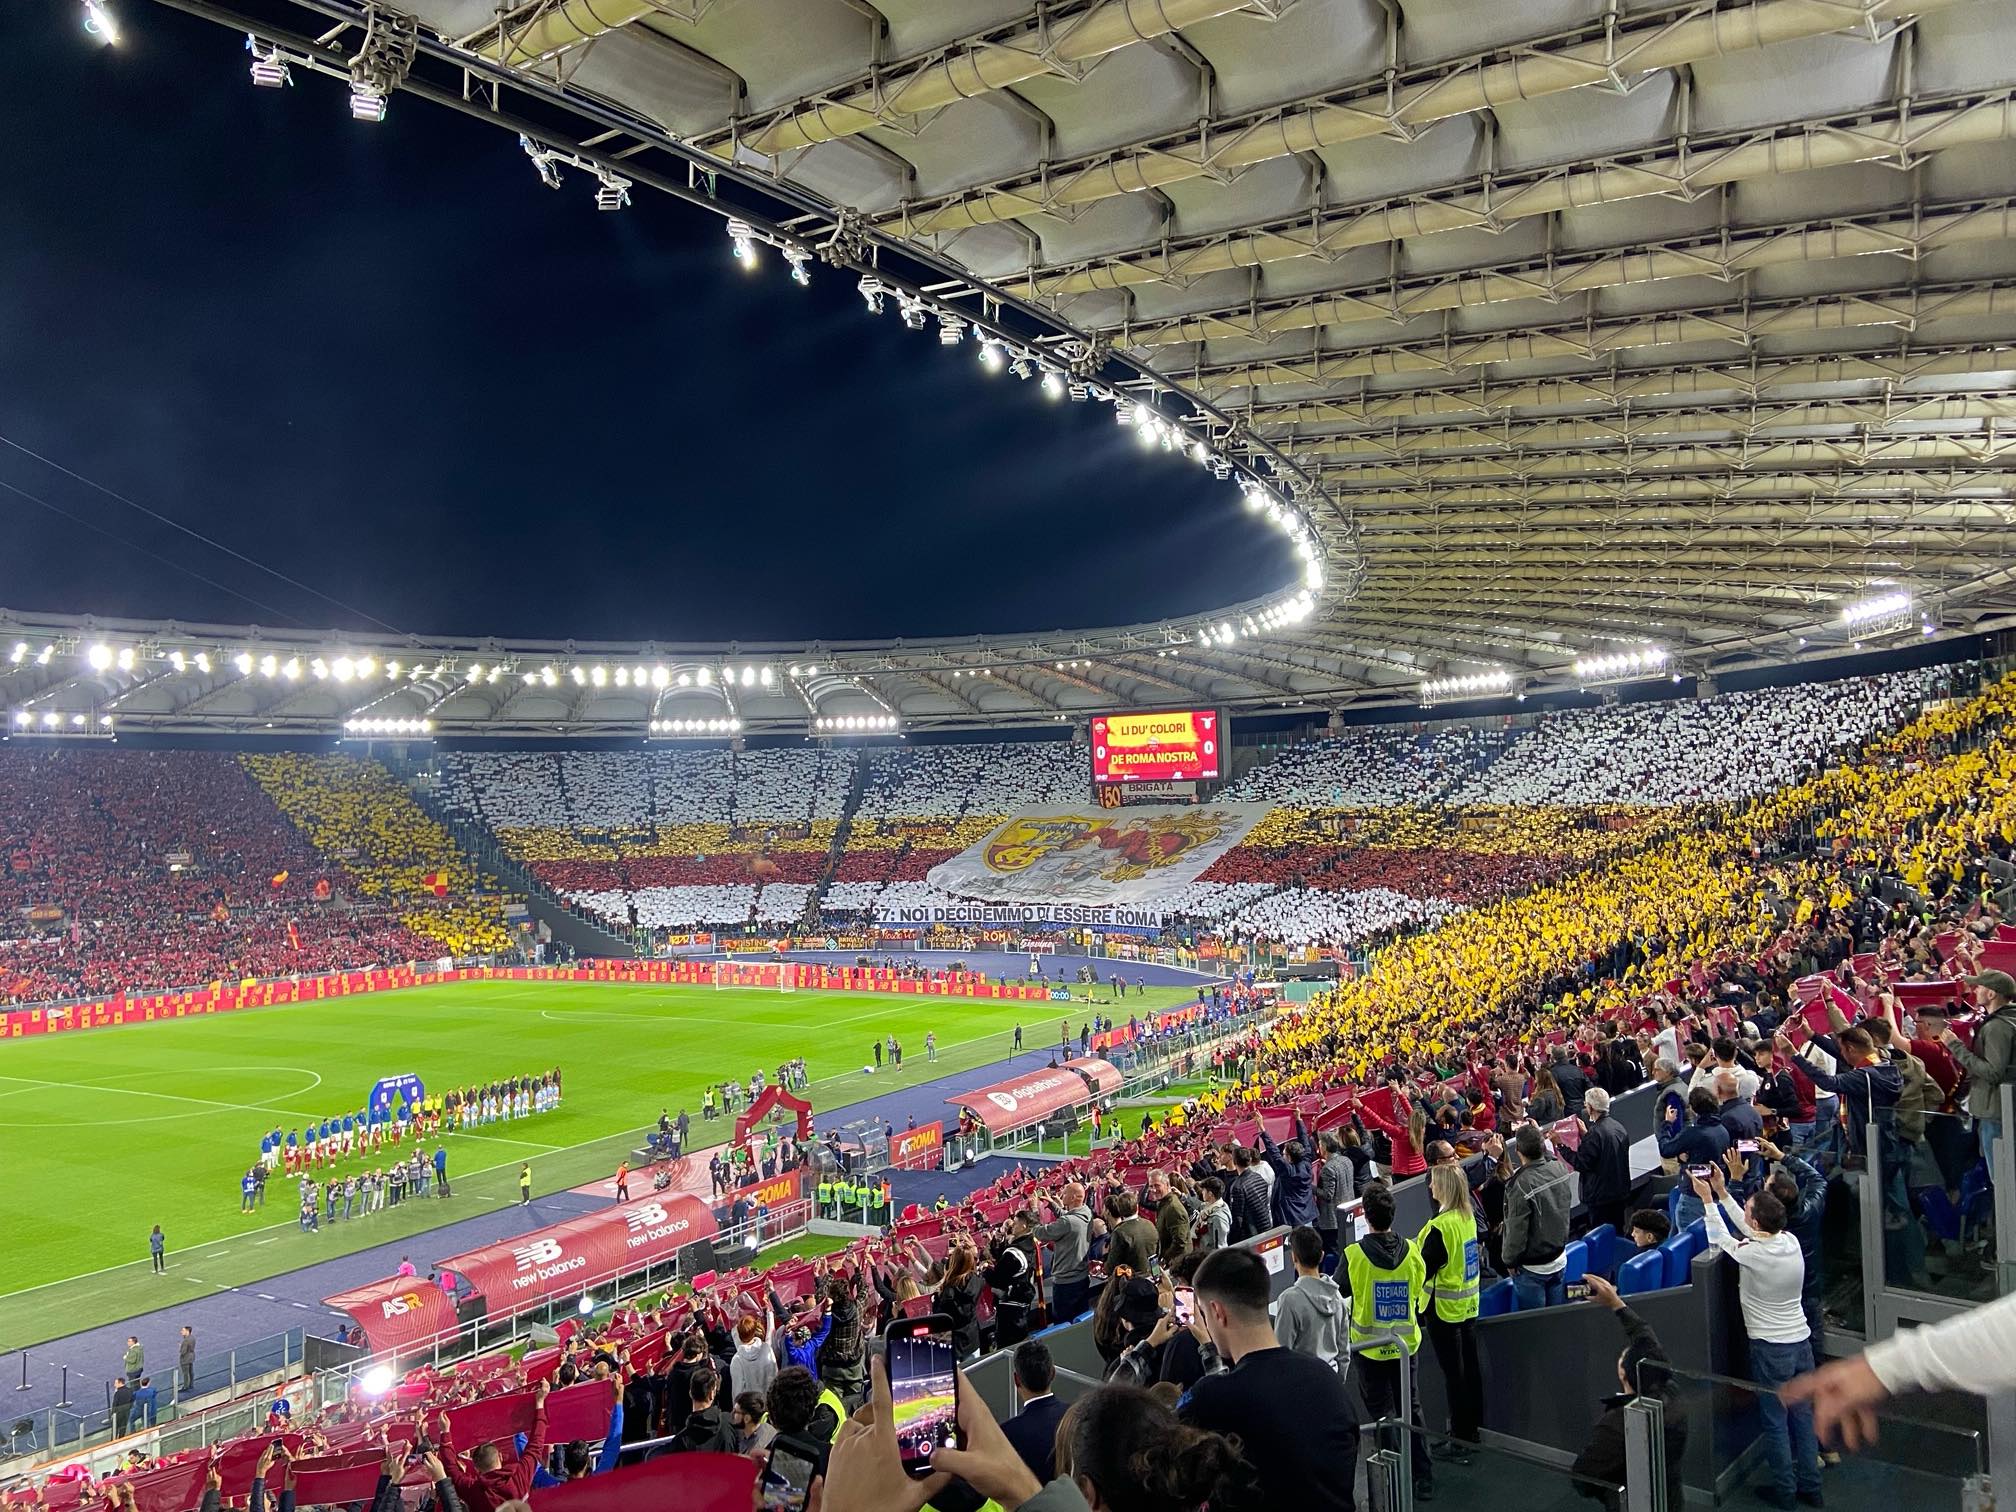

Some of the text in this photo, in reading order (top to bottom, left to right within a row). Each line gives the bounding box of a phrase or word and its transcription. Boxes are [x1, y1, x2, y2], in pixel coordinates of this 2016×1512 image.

[1121, 723, 1186, 736] LI DU' COLORI
[1096, 746, 1106, 760] 0
[1204, 740, 1214, 754] 0
[1111, 751, 1198, 765] DE ROMA NOSTRA
[1128, 782, 1174, 792] BRIGATA
[1103, 785, 1120, 808] 50
[900, 908, 929, 921] NOI
[934, 907, 1034, 921] DECIDEMMO
[1054, 908, 1111, 923] ESSERE
[1115, 910, 1158, 927] ROMA
[1051, 991, 1070, 1000] 00:00
[627, 1219, 689, 1248] new balance
[512, 1256, 586, 1290] new balance
